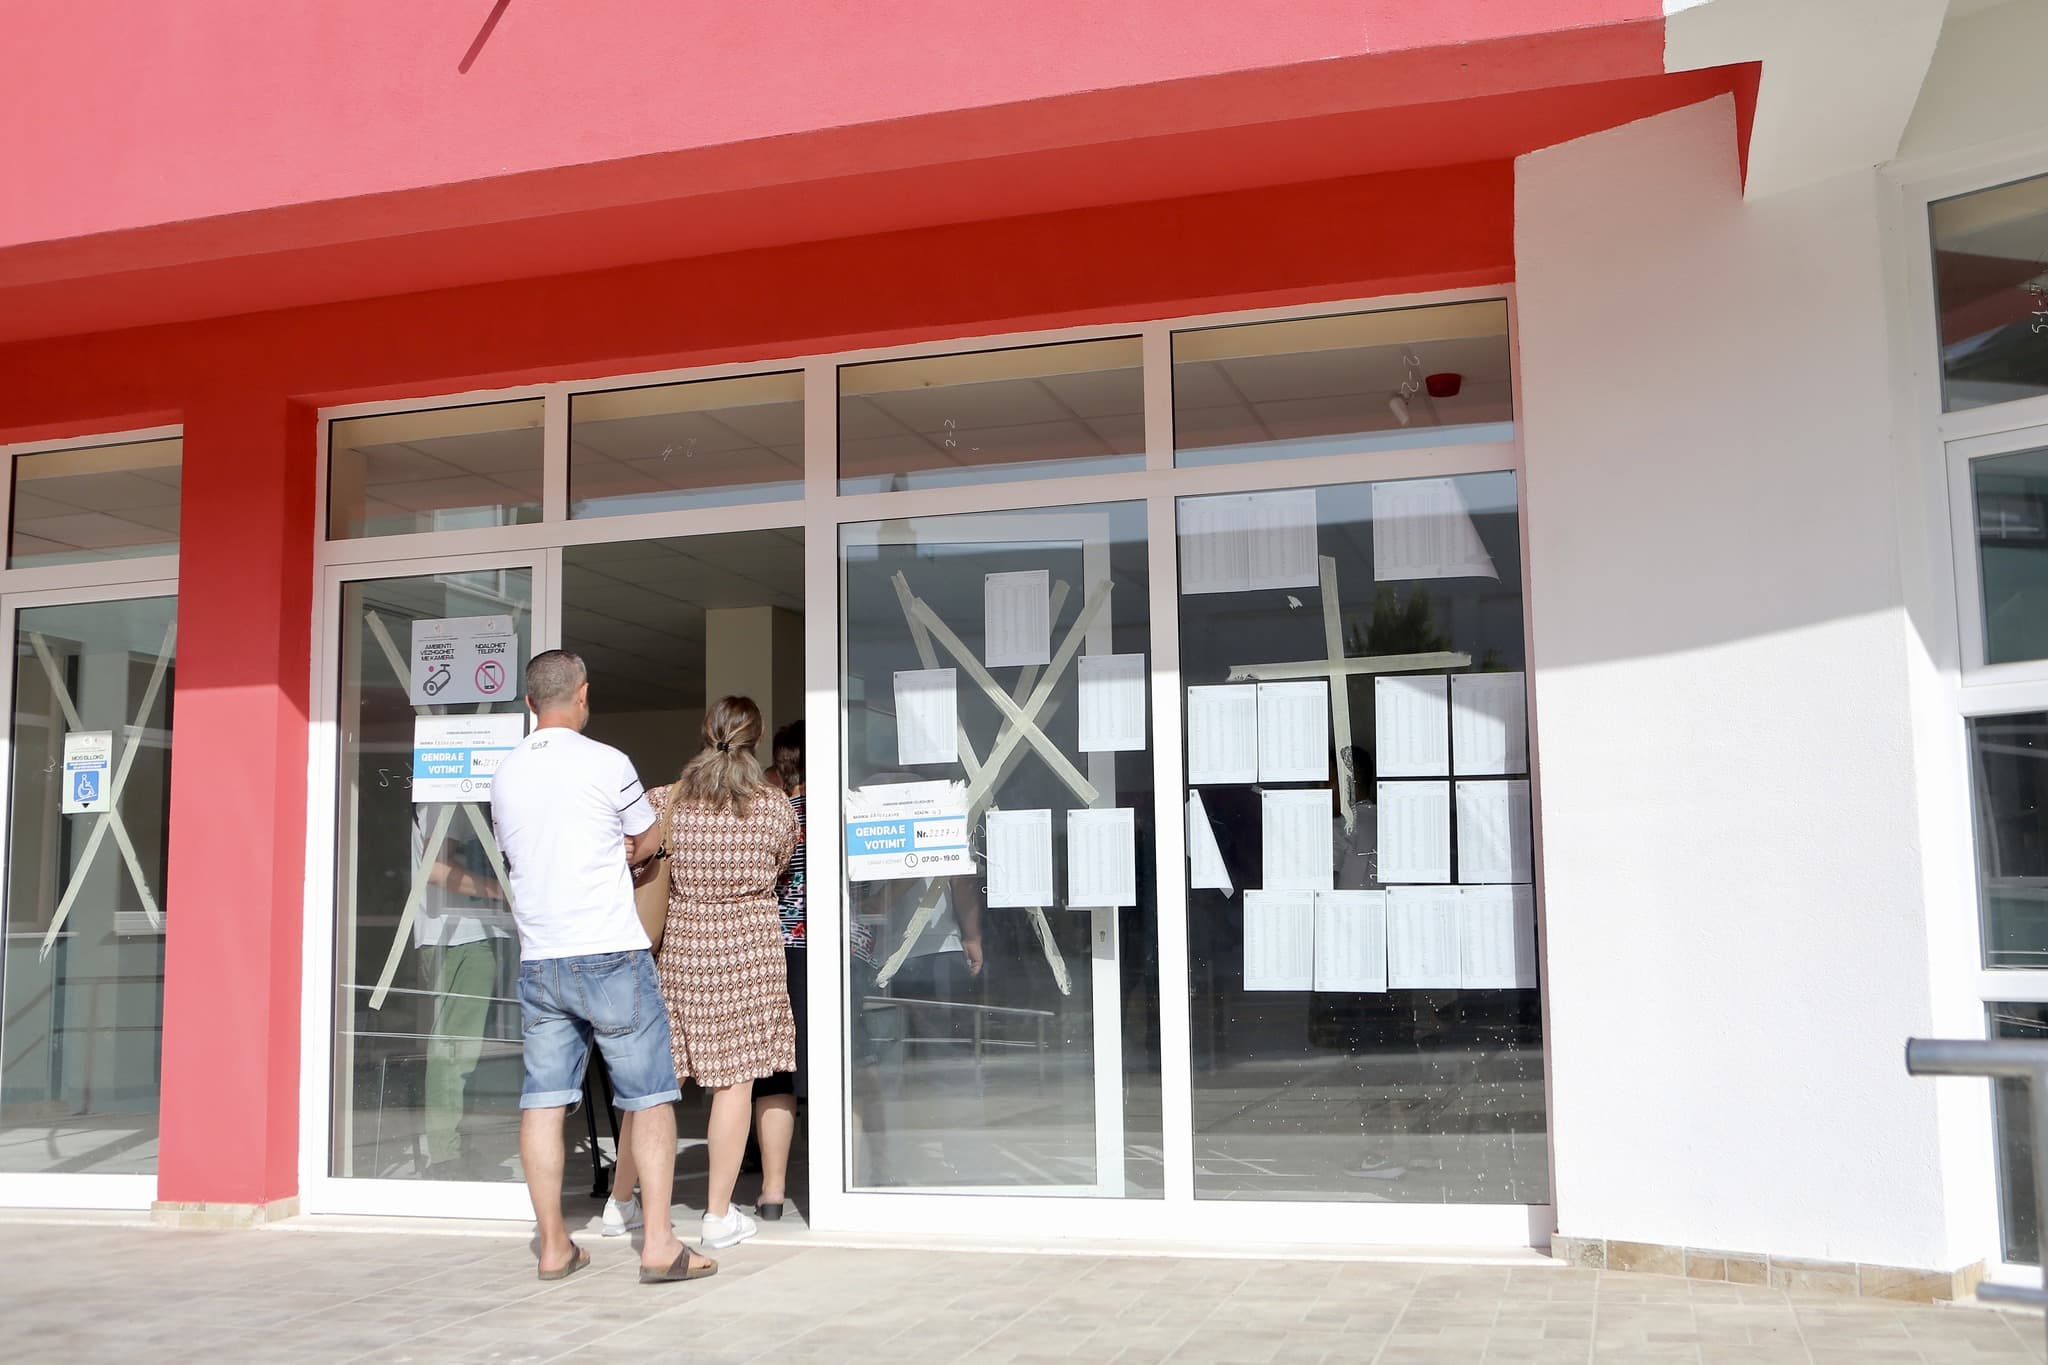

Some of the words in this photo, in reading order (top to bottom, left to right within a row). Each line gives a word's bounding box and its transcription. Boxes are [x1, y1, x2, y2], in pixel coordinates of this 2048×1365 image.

[421, 752, 457, 762] QENDRA
[458, 752, 465, 761] E
[473, 758, 483, 766] Nr.
[428, 765, 464, 774] VOTIMIT
[856, 826, 898, 837] QENDRA
[899, 824, 905, 834] E
[916, 830, 929, 839] Nr.
[865, 838, 906, 850] VOTIMIT
